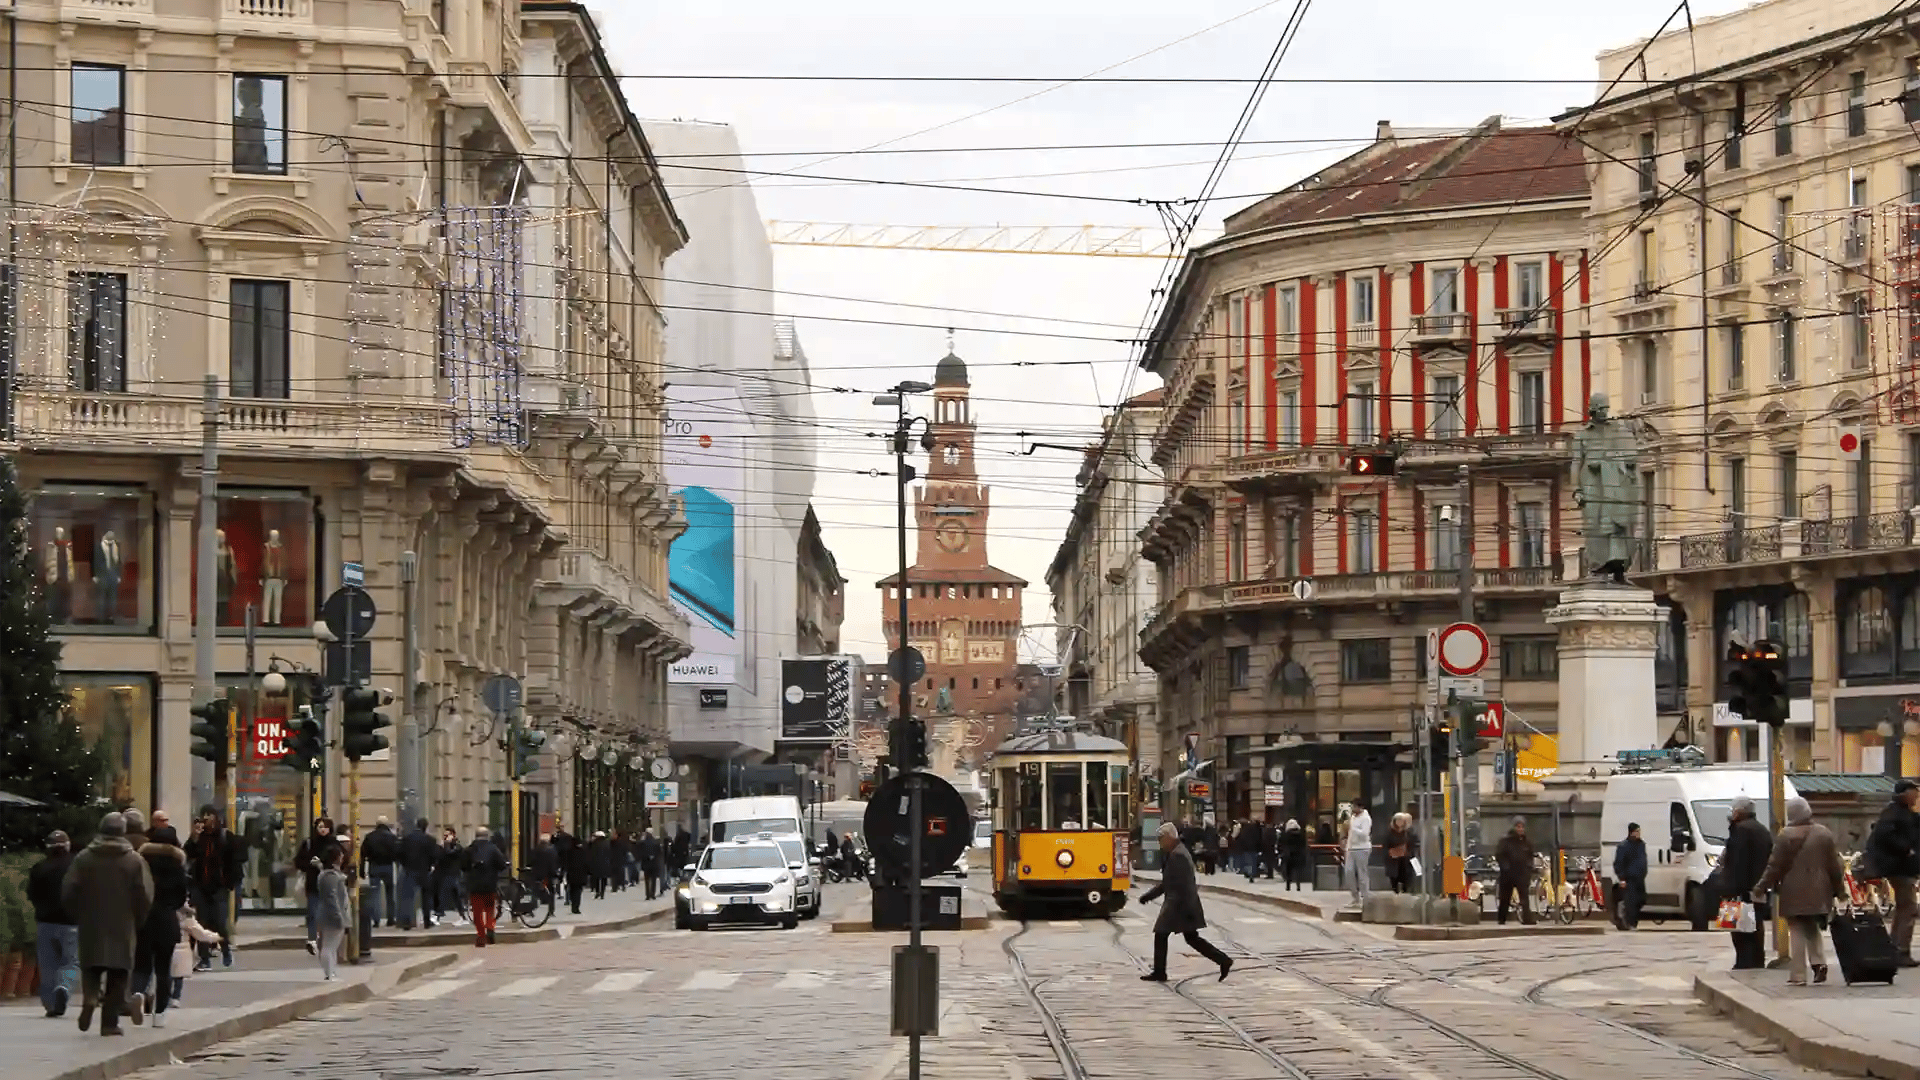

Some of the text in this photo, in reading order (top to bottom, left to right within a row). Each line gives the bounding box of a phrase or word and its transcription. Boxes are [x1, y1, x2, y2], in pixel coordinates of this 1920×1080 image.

[664, 419, 692, 434] Pro
[672, 665, 719, 676] HUAWEI
[1025, 763, 1040, 776] 19
